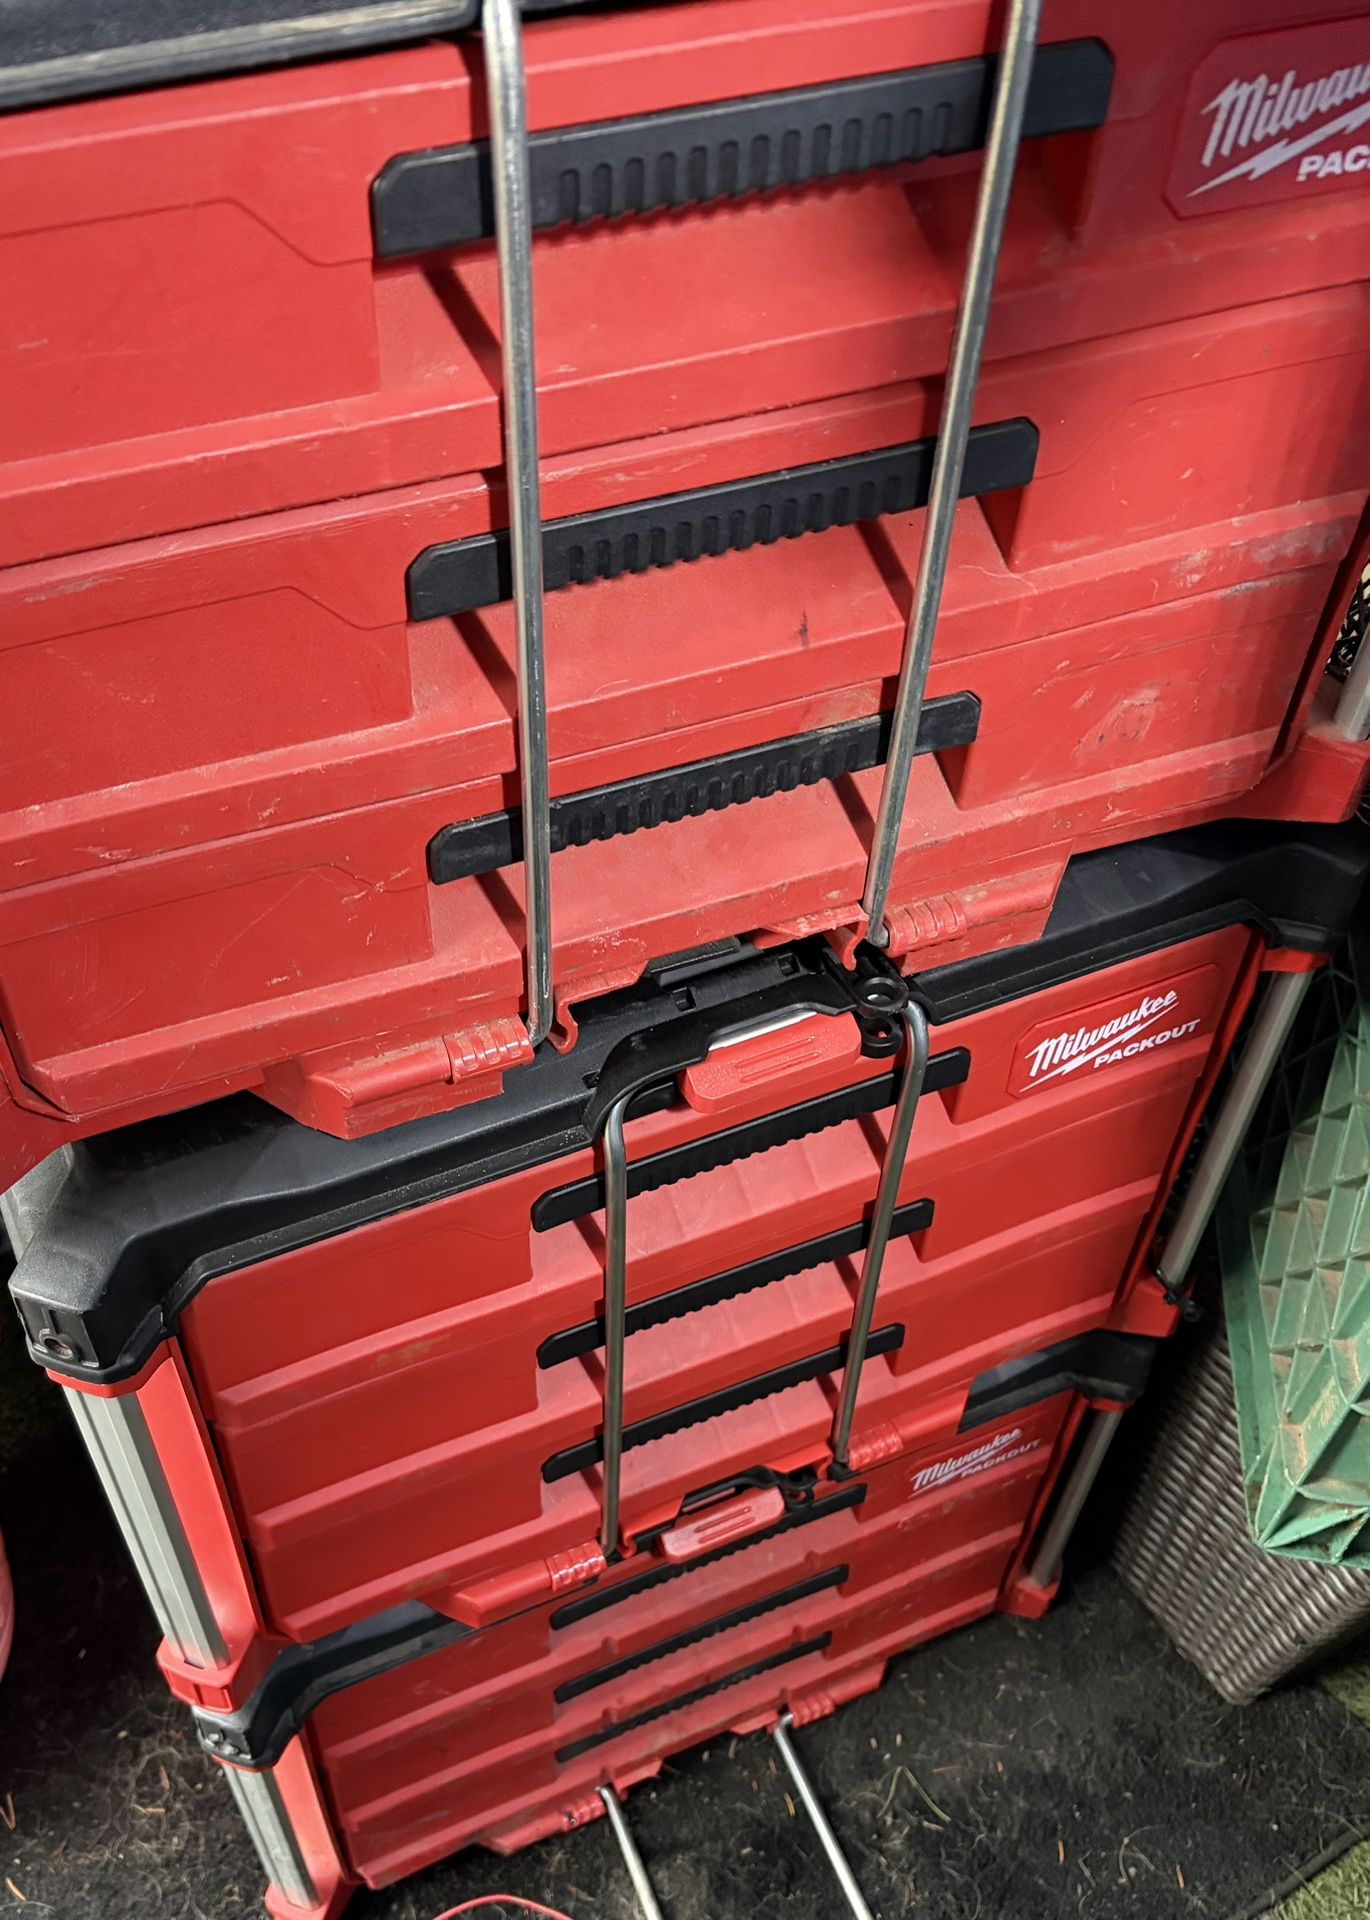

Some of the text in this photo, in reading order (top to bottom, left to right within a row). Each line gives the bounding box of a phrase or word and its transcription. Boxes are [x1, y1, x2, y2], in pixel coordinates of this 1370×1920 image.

[1296, 144, 1370, 182] PAC
[1025, 990, 1178, 1077] Milwaukee
[1093, 1018, 1201, 1069] PACKOUT
[910, 1428, 1023, 1491] Milwaukee
[960, 1438, 1041, 1478] PACKOUT
